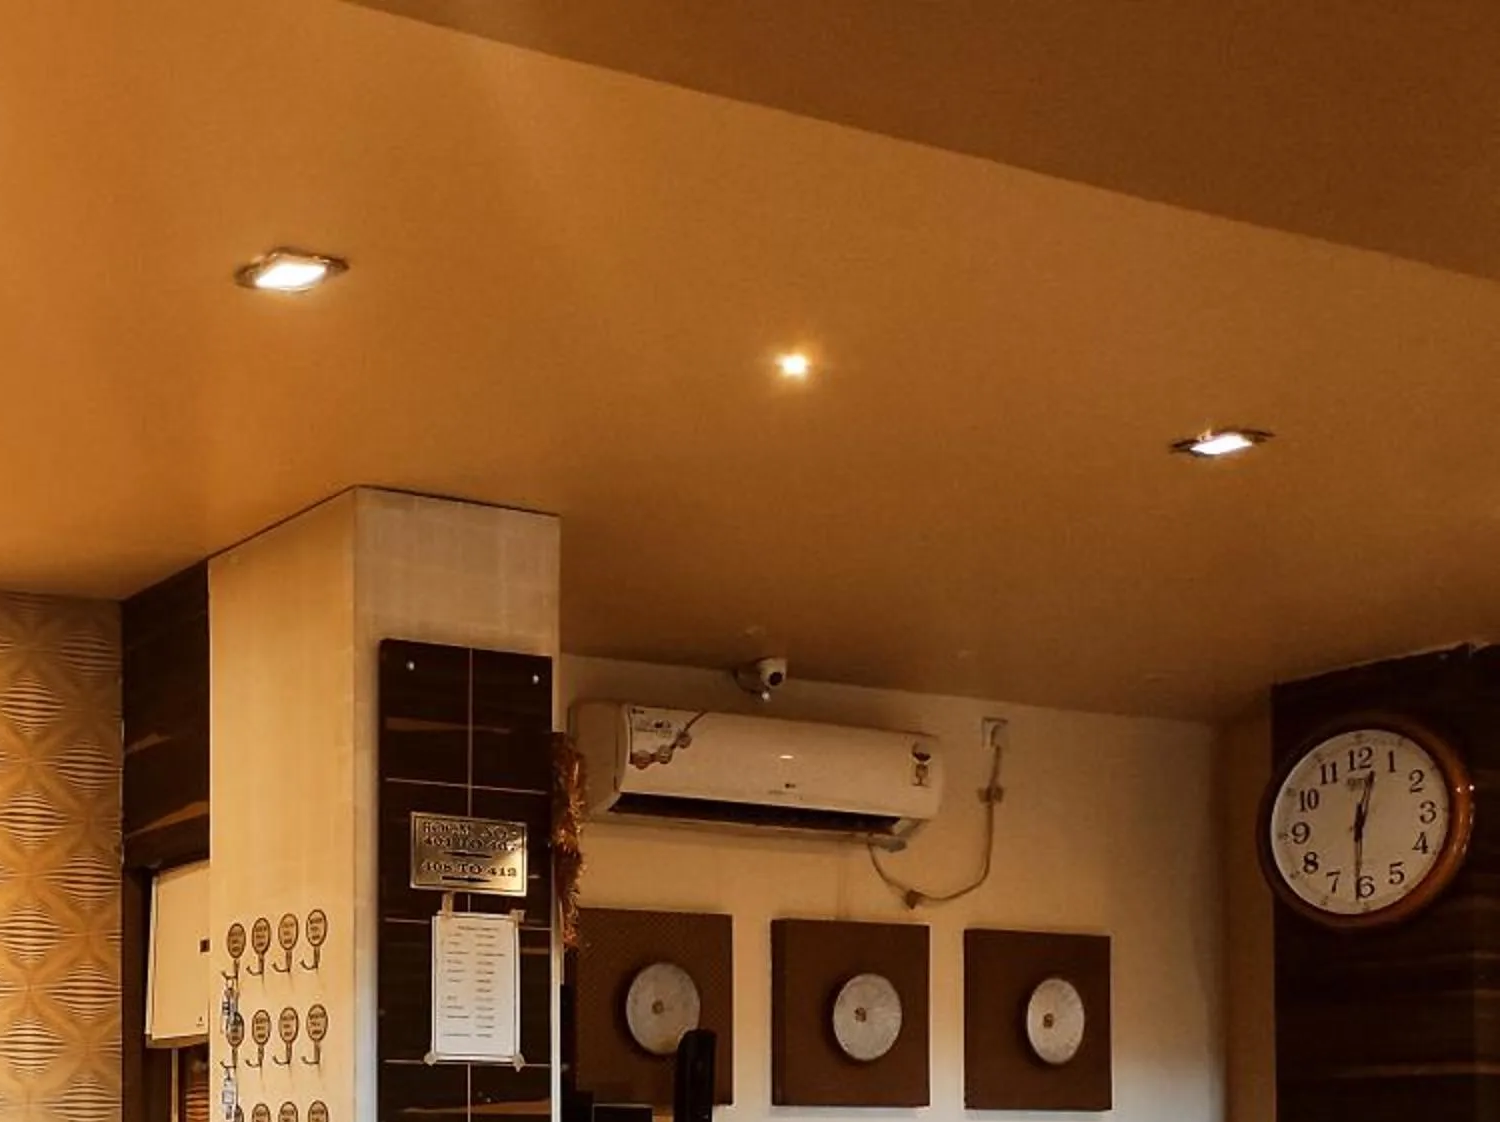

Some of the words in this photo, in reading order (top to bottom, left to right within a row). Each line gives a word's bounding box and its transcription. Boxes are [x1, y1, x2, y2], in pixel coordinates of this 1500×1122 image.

[1347, 746, 1373, 773] 12
[1387, 750, 1397, 773] 1
[1319, 761, 1339, 786] 11
[1408, 769, 1425, 793] 2
[1299, 788, 1320, 813] 10
[1419, 801, 1437, 824] 3
[1291, 821, 1311, 845] 9
[1411, 831, 1430, 855] 4
[458, 862, 483, 875] TO
[486, 866, 518, 878] 412
[1302, 851, 1320, 875] 8
[1388, 861, 1405, 885] 5
[1326, 870, 1342, 894] 7
[1357, 874, 1376, 898] 6
